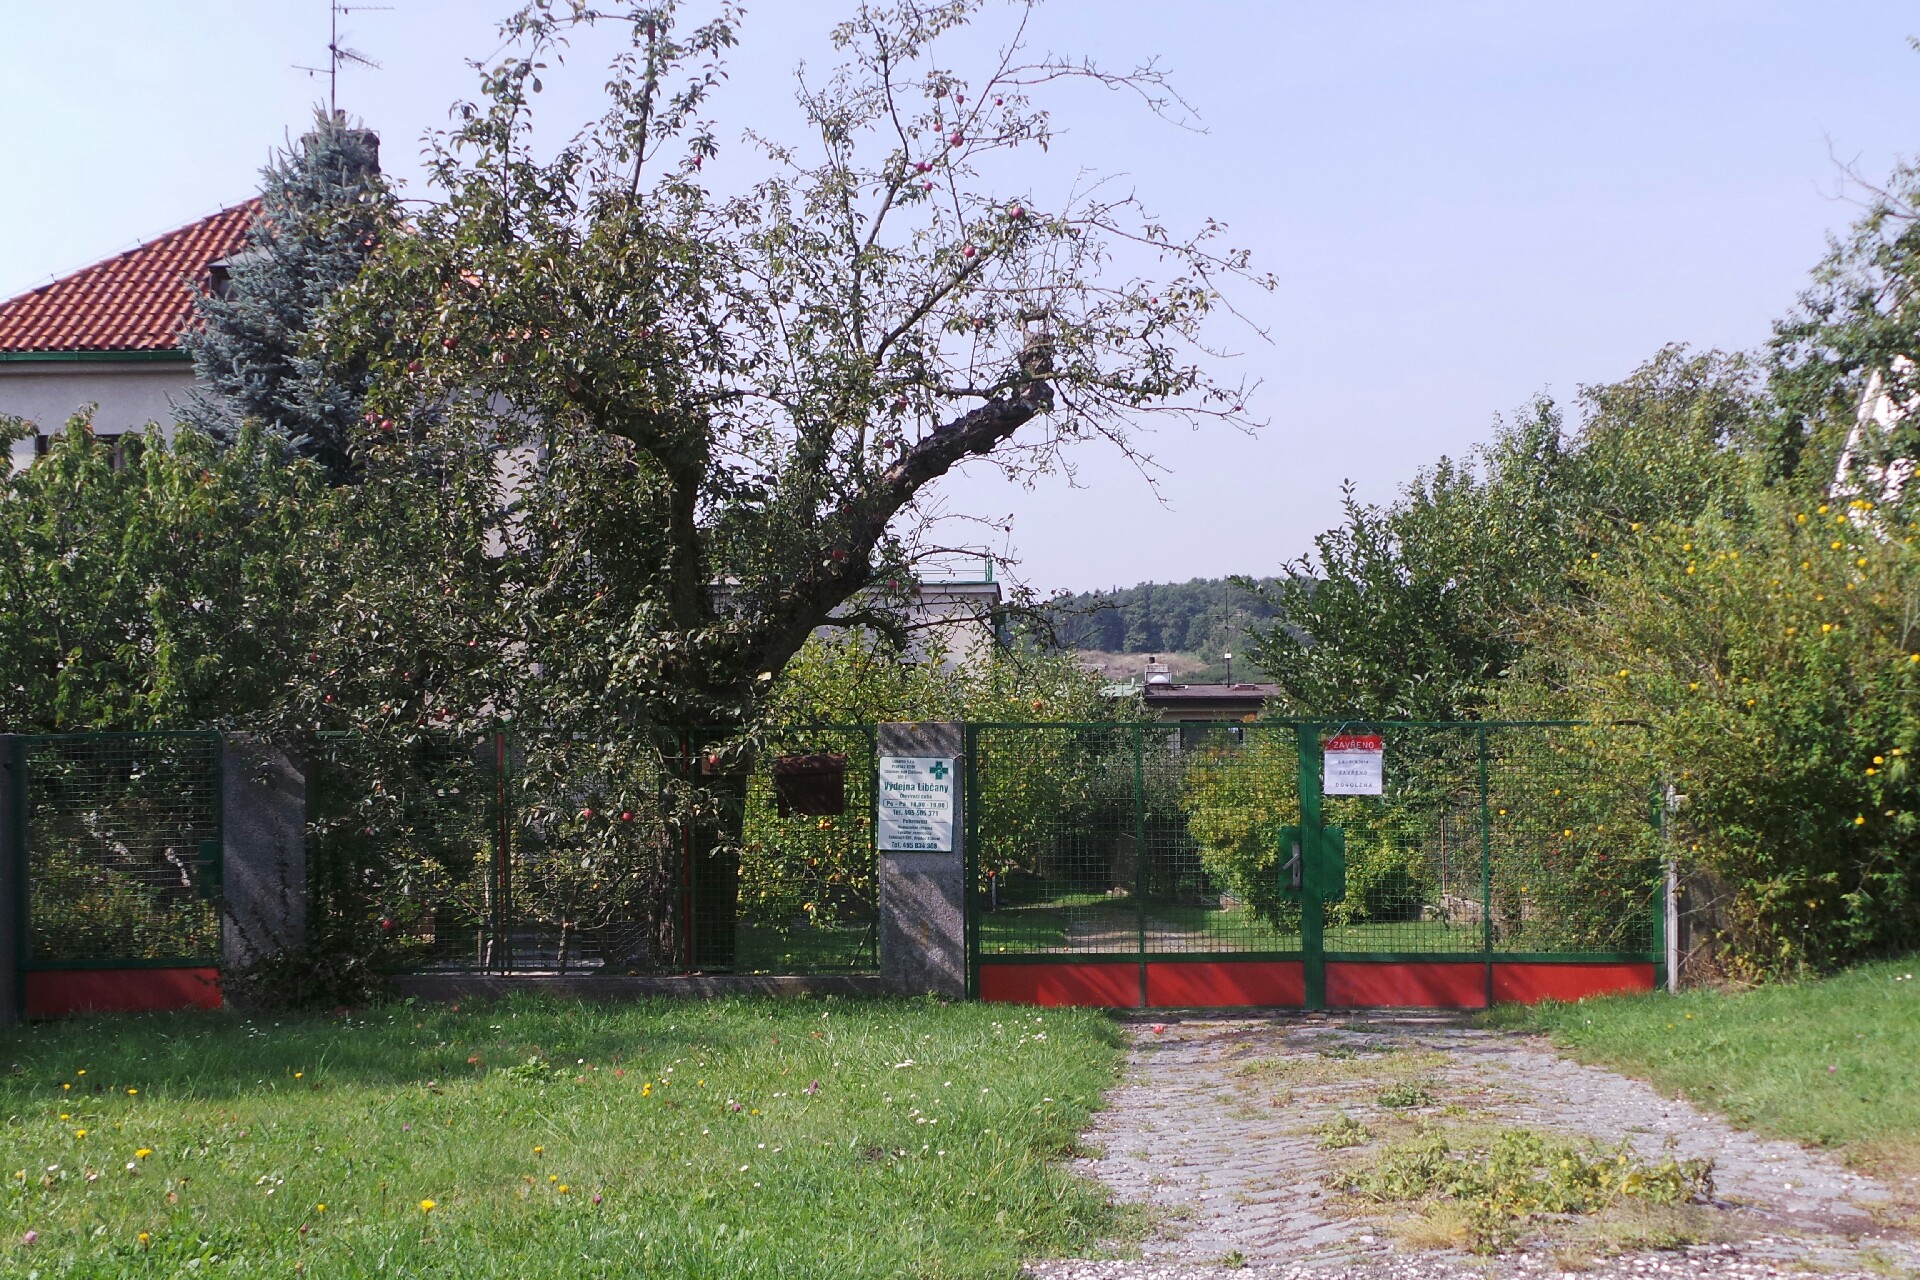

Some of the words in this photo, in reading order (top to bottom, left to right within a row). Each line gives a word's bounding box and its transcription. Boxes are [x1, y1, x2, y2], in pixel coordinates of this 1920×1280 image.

[1333, 739, 1375, 749] ZAVŘENO
[884, 781, 915, 792] Výdejna
[917, 782, 949, 794] Libčany
